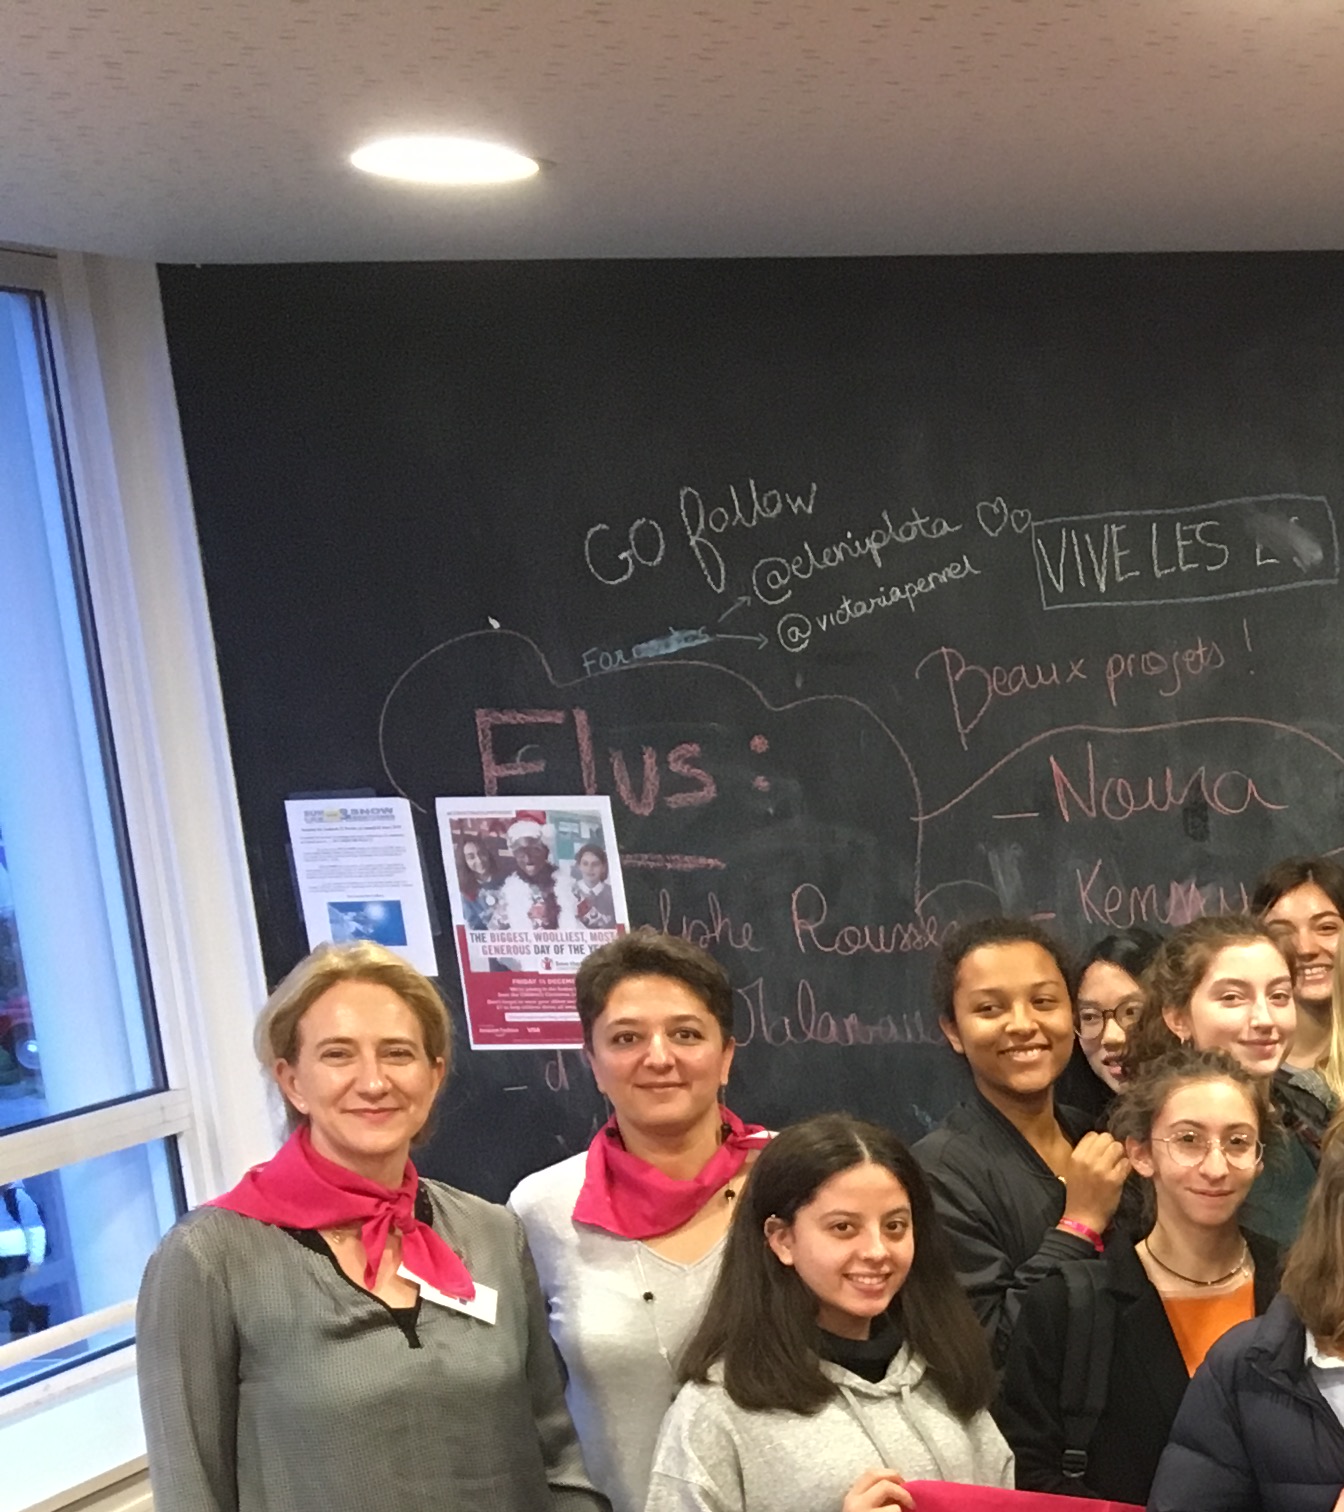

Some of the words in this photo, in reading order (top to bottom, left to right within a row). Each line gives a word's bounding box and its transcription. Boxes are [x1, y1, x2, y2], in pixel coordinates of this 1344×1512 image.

[584, 517, 666, 585] GO
[679, 478, 818, 593] follow
[1037, 525, 1142, 593] VIVE
[1150, 520, 1230, 579] LES
[914, 646, 1088, 750] Beaux
[1105, 636, 1226, 707] projets
[469, 932, 488, 943] THE
[490, 931, 532, 944] BIGGEST,
[533, 931, 588, 944] WOOLLIEST,
[481, 944, 532, 956] GENEROUS
[533, 944, 550, 955] DAY
[553, 944, 565, 955] OF
[567, 944, 586, 955] THE
